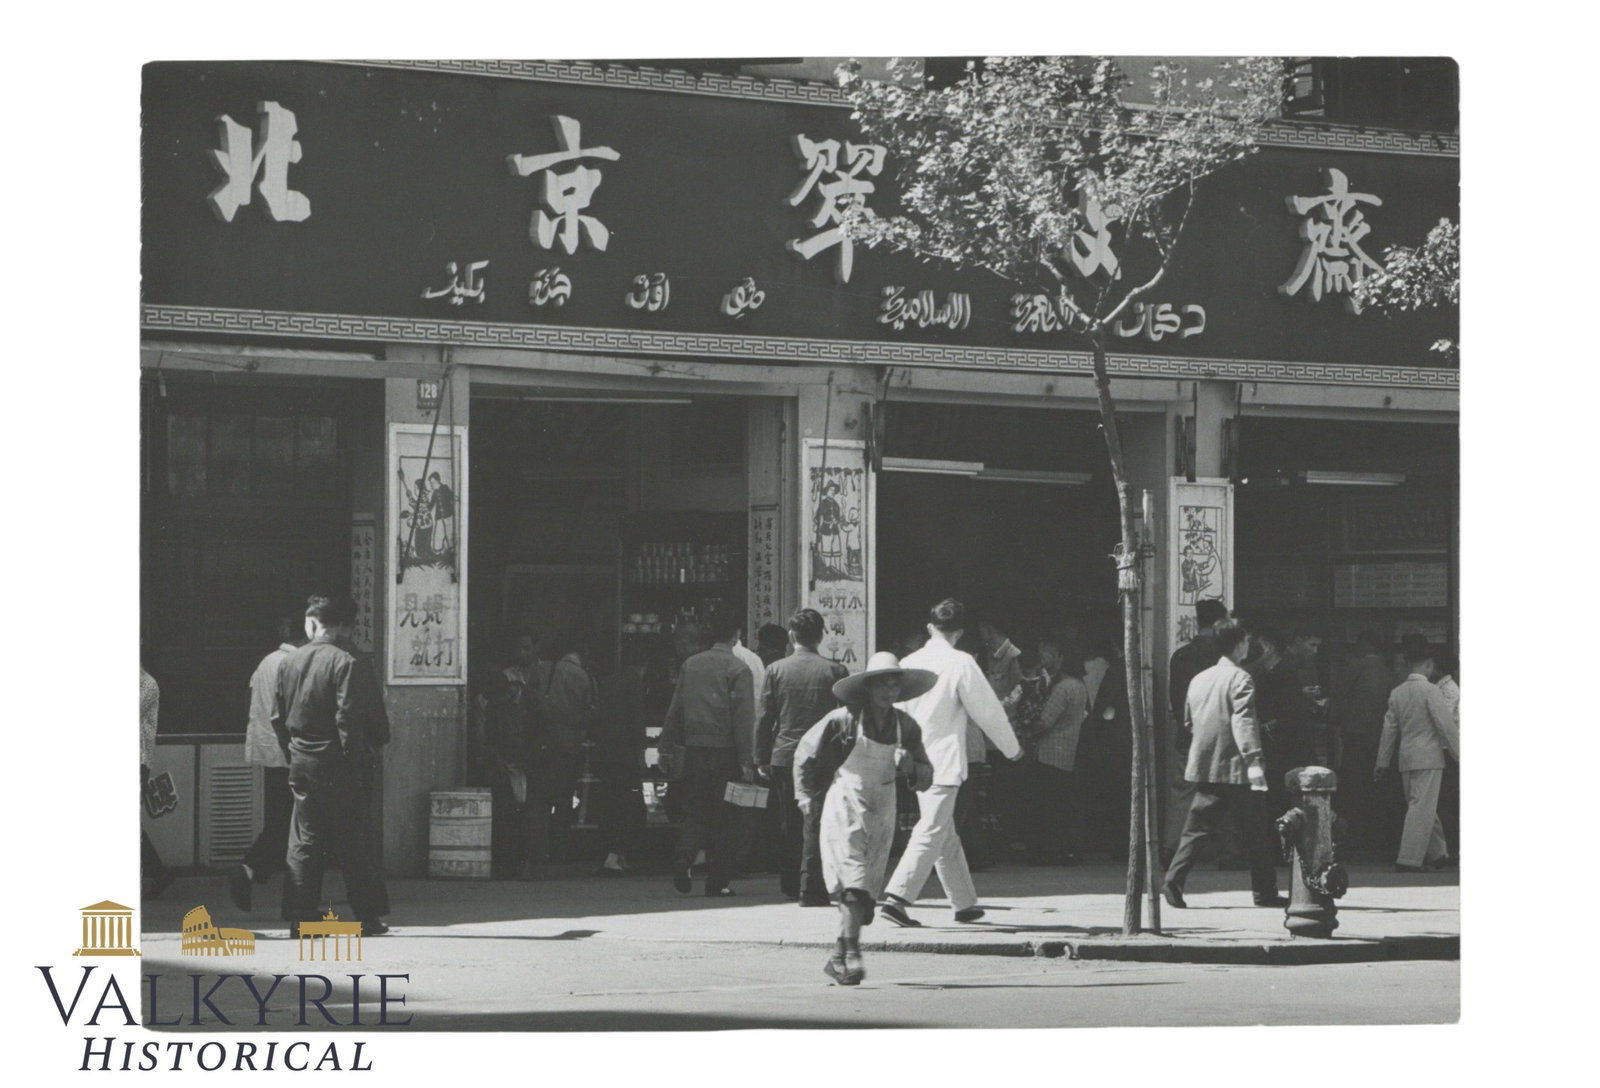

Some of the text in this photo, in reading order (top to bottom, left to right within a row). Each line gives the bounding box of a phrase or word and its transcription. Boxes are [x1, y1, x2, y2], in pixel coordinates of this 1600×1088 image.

[877, 285, 971, 332] الاسلامية
[1115, 302, 1206, 342] دكان
[420, 383, 438, 399] 128
